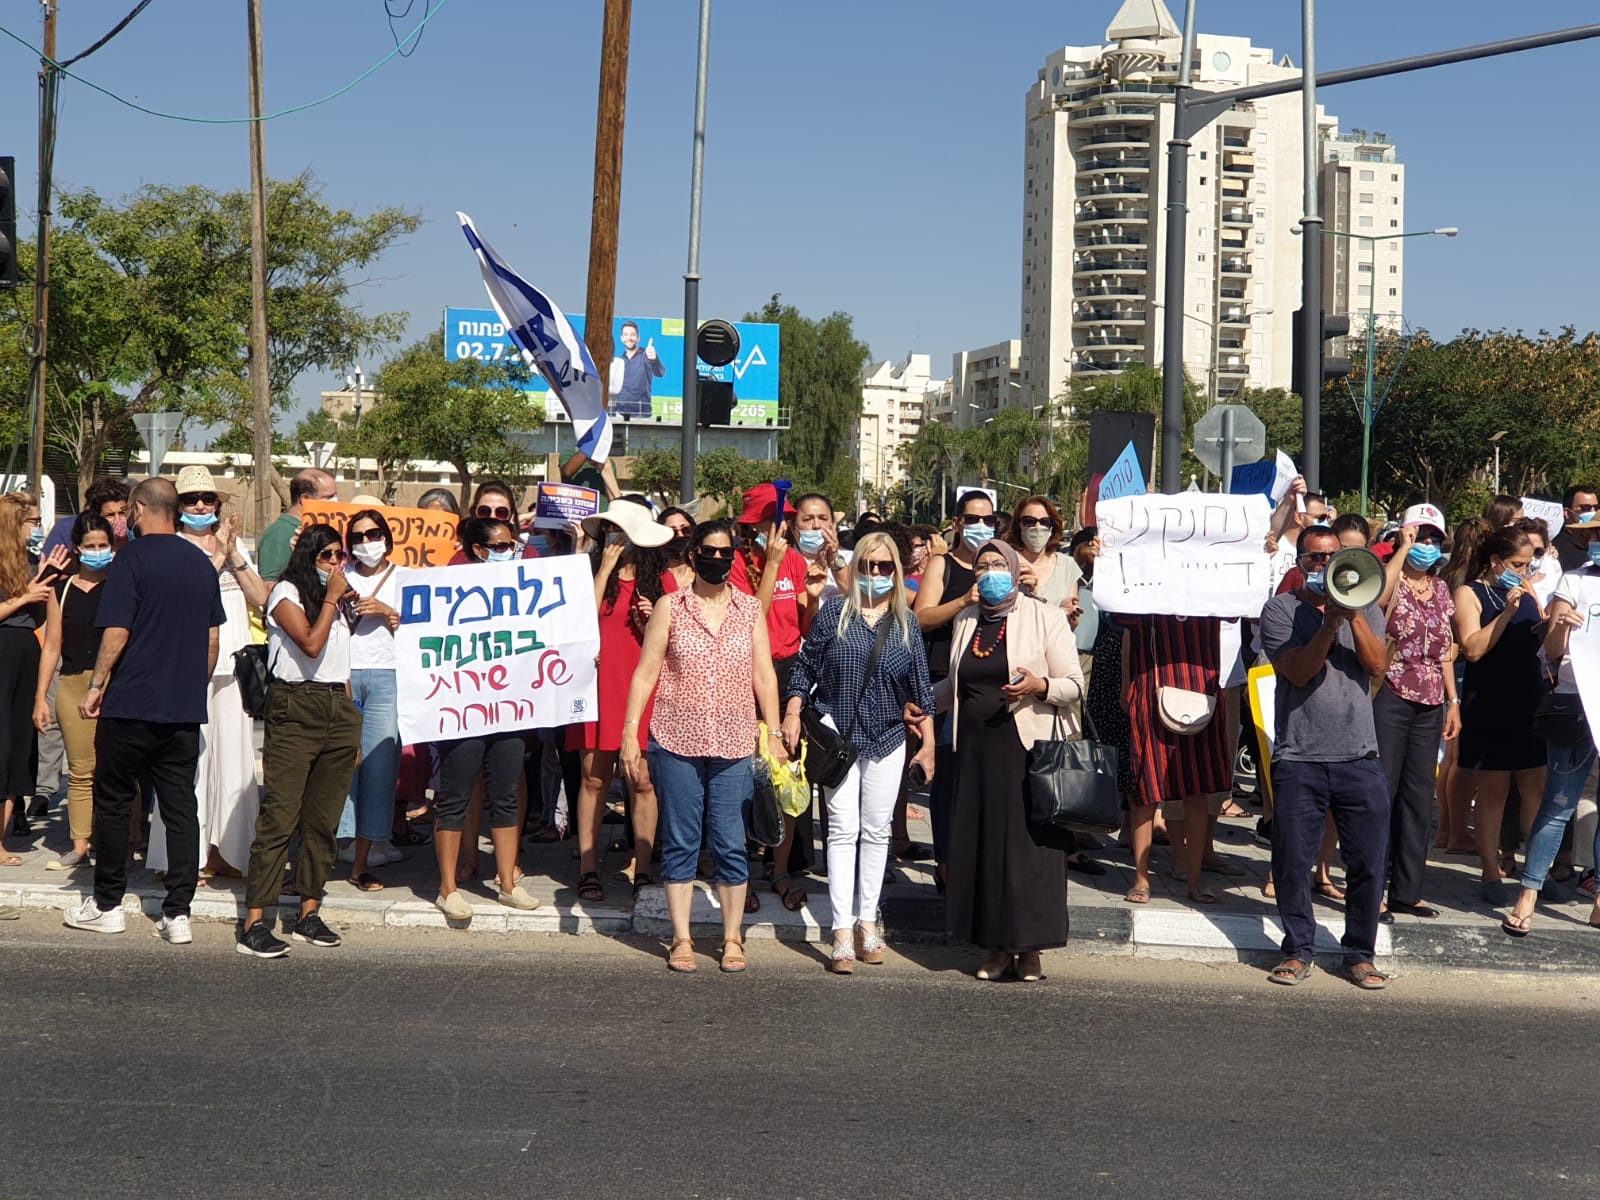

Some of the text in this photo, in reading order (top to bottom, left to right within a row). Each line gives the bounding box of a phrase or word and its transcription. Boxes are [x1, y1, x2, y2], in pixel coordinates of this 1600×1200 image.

[459, 321, 505, 337] פתוח
[1122, 500, 1250, 559] נחנקנו
[403, 543, 436, 567] את
[400, 565, 567, 626] נלחמים
[419, 630, 546, 669] בהזנחה
[425, 650, 574, 700] של שירותי
[439, 699, 535, 734] הרווחה
